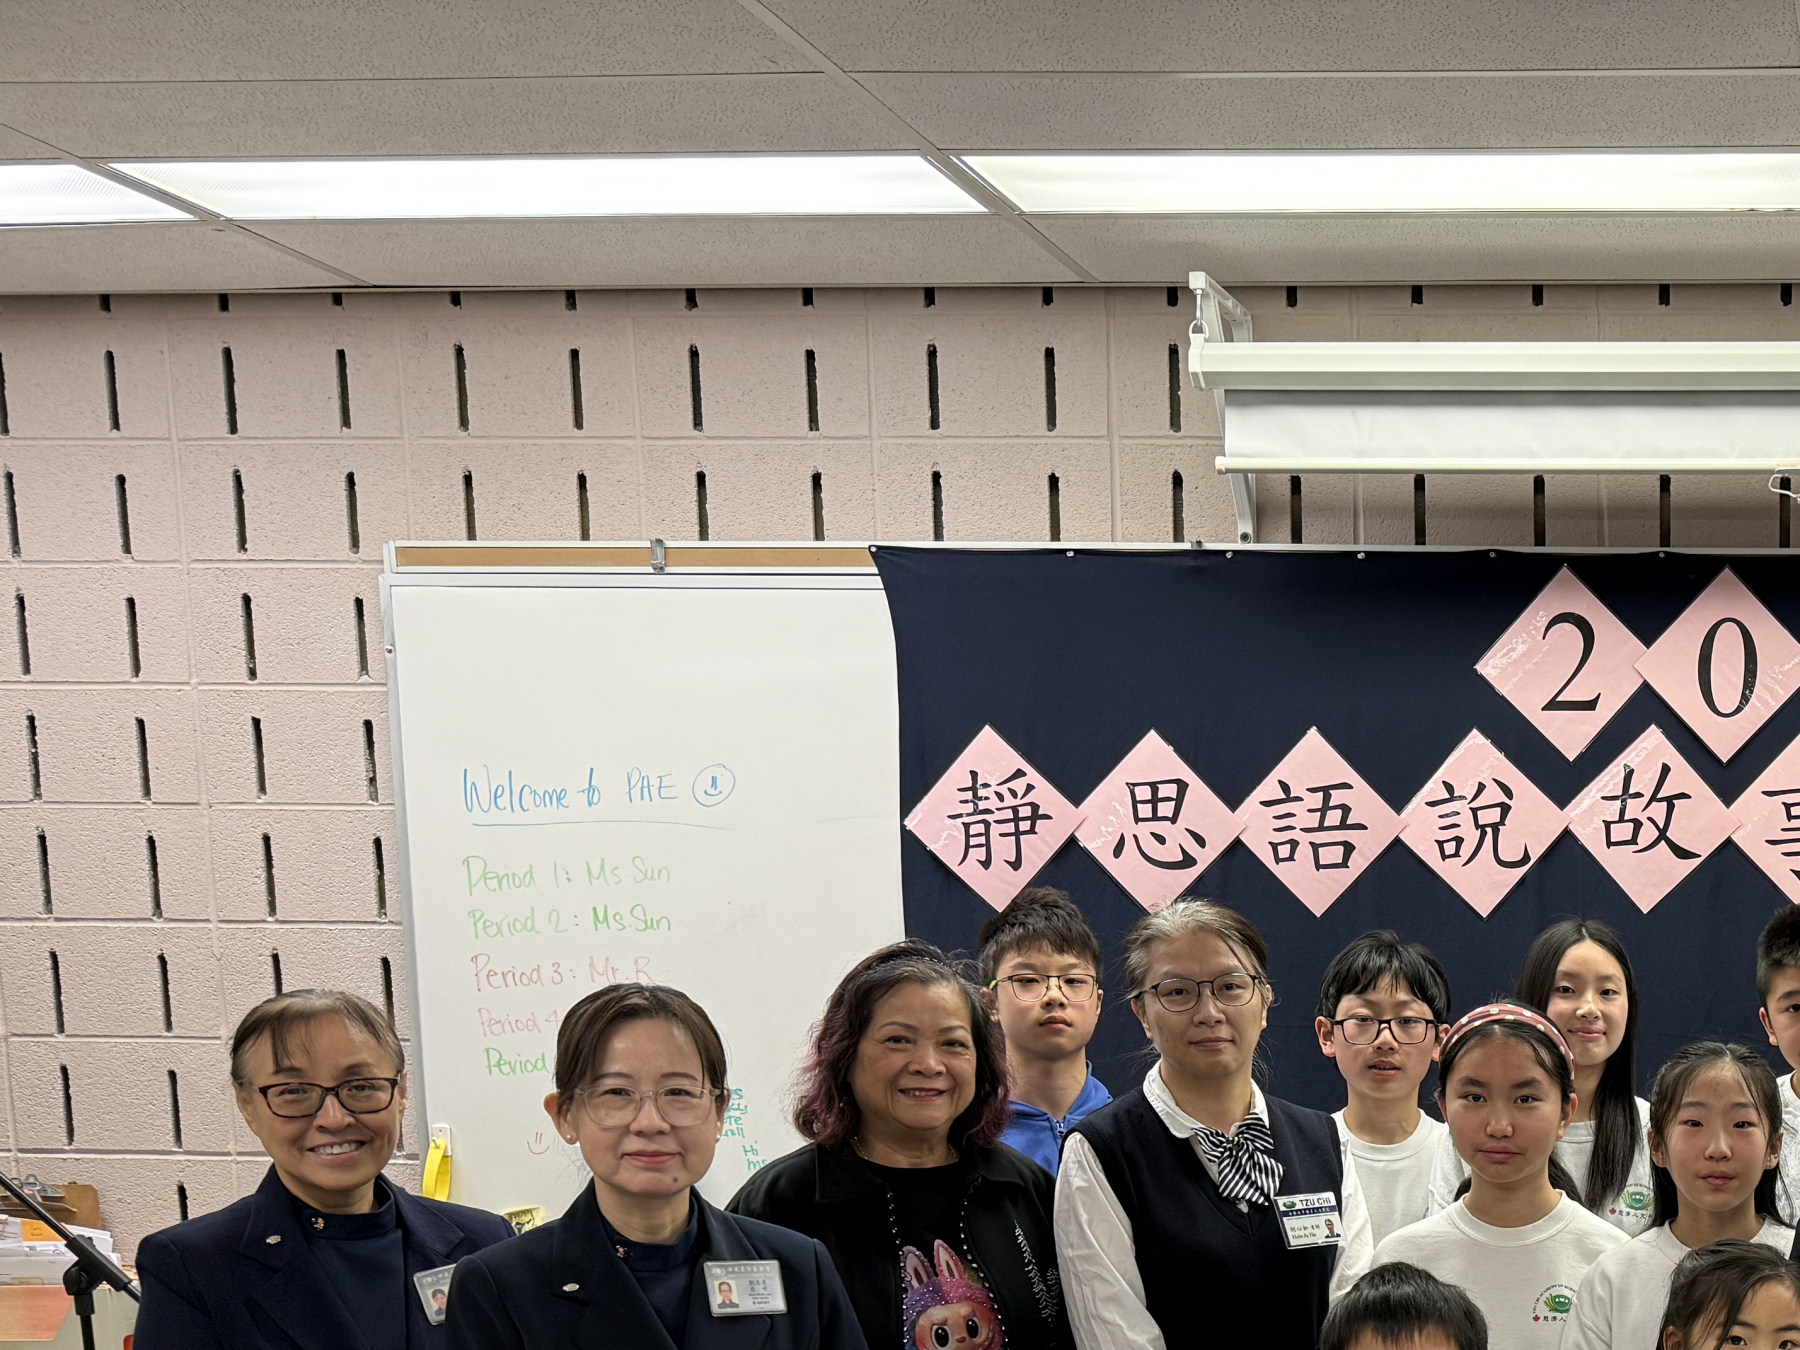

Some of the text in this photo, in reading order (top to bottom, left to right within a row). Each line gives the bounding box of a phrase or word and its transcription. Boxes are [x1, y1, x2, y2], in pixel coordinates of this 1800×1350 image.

[463, 765, 569, 813] Welcome
[576, 767, 600, 807] to
[462, 855, 536, 896] Period
[632, 855, 670, 883] Sun
[468, 906, 540, 939] Period
[630, 903, 671, 932] Sun
[470, 953, 543, 991] Period
[477, 1007, 542, 1037] Period
[483, 1047, 549, 1076] Period
[1299, 1197, 1331, 1207] TZU CHI
